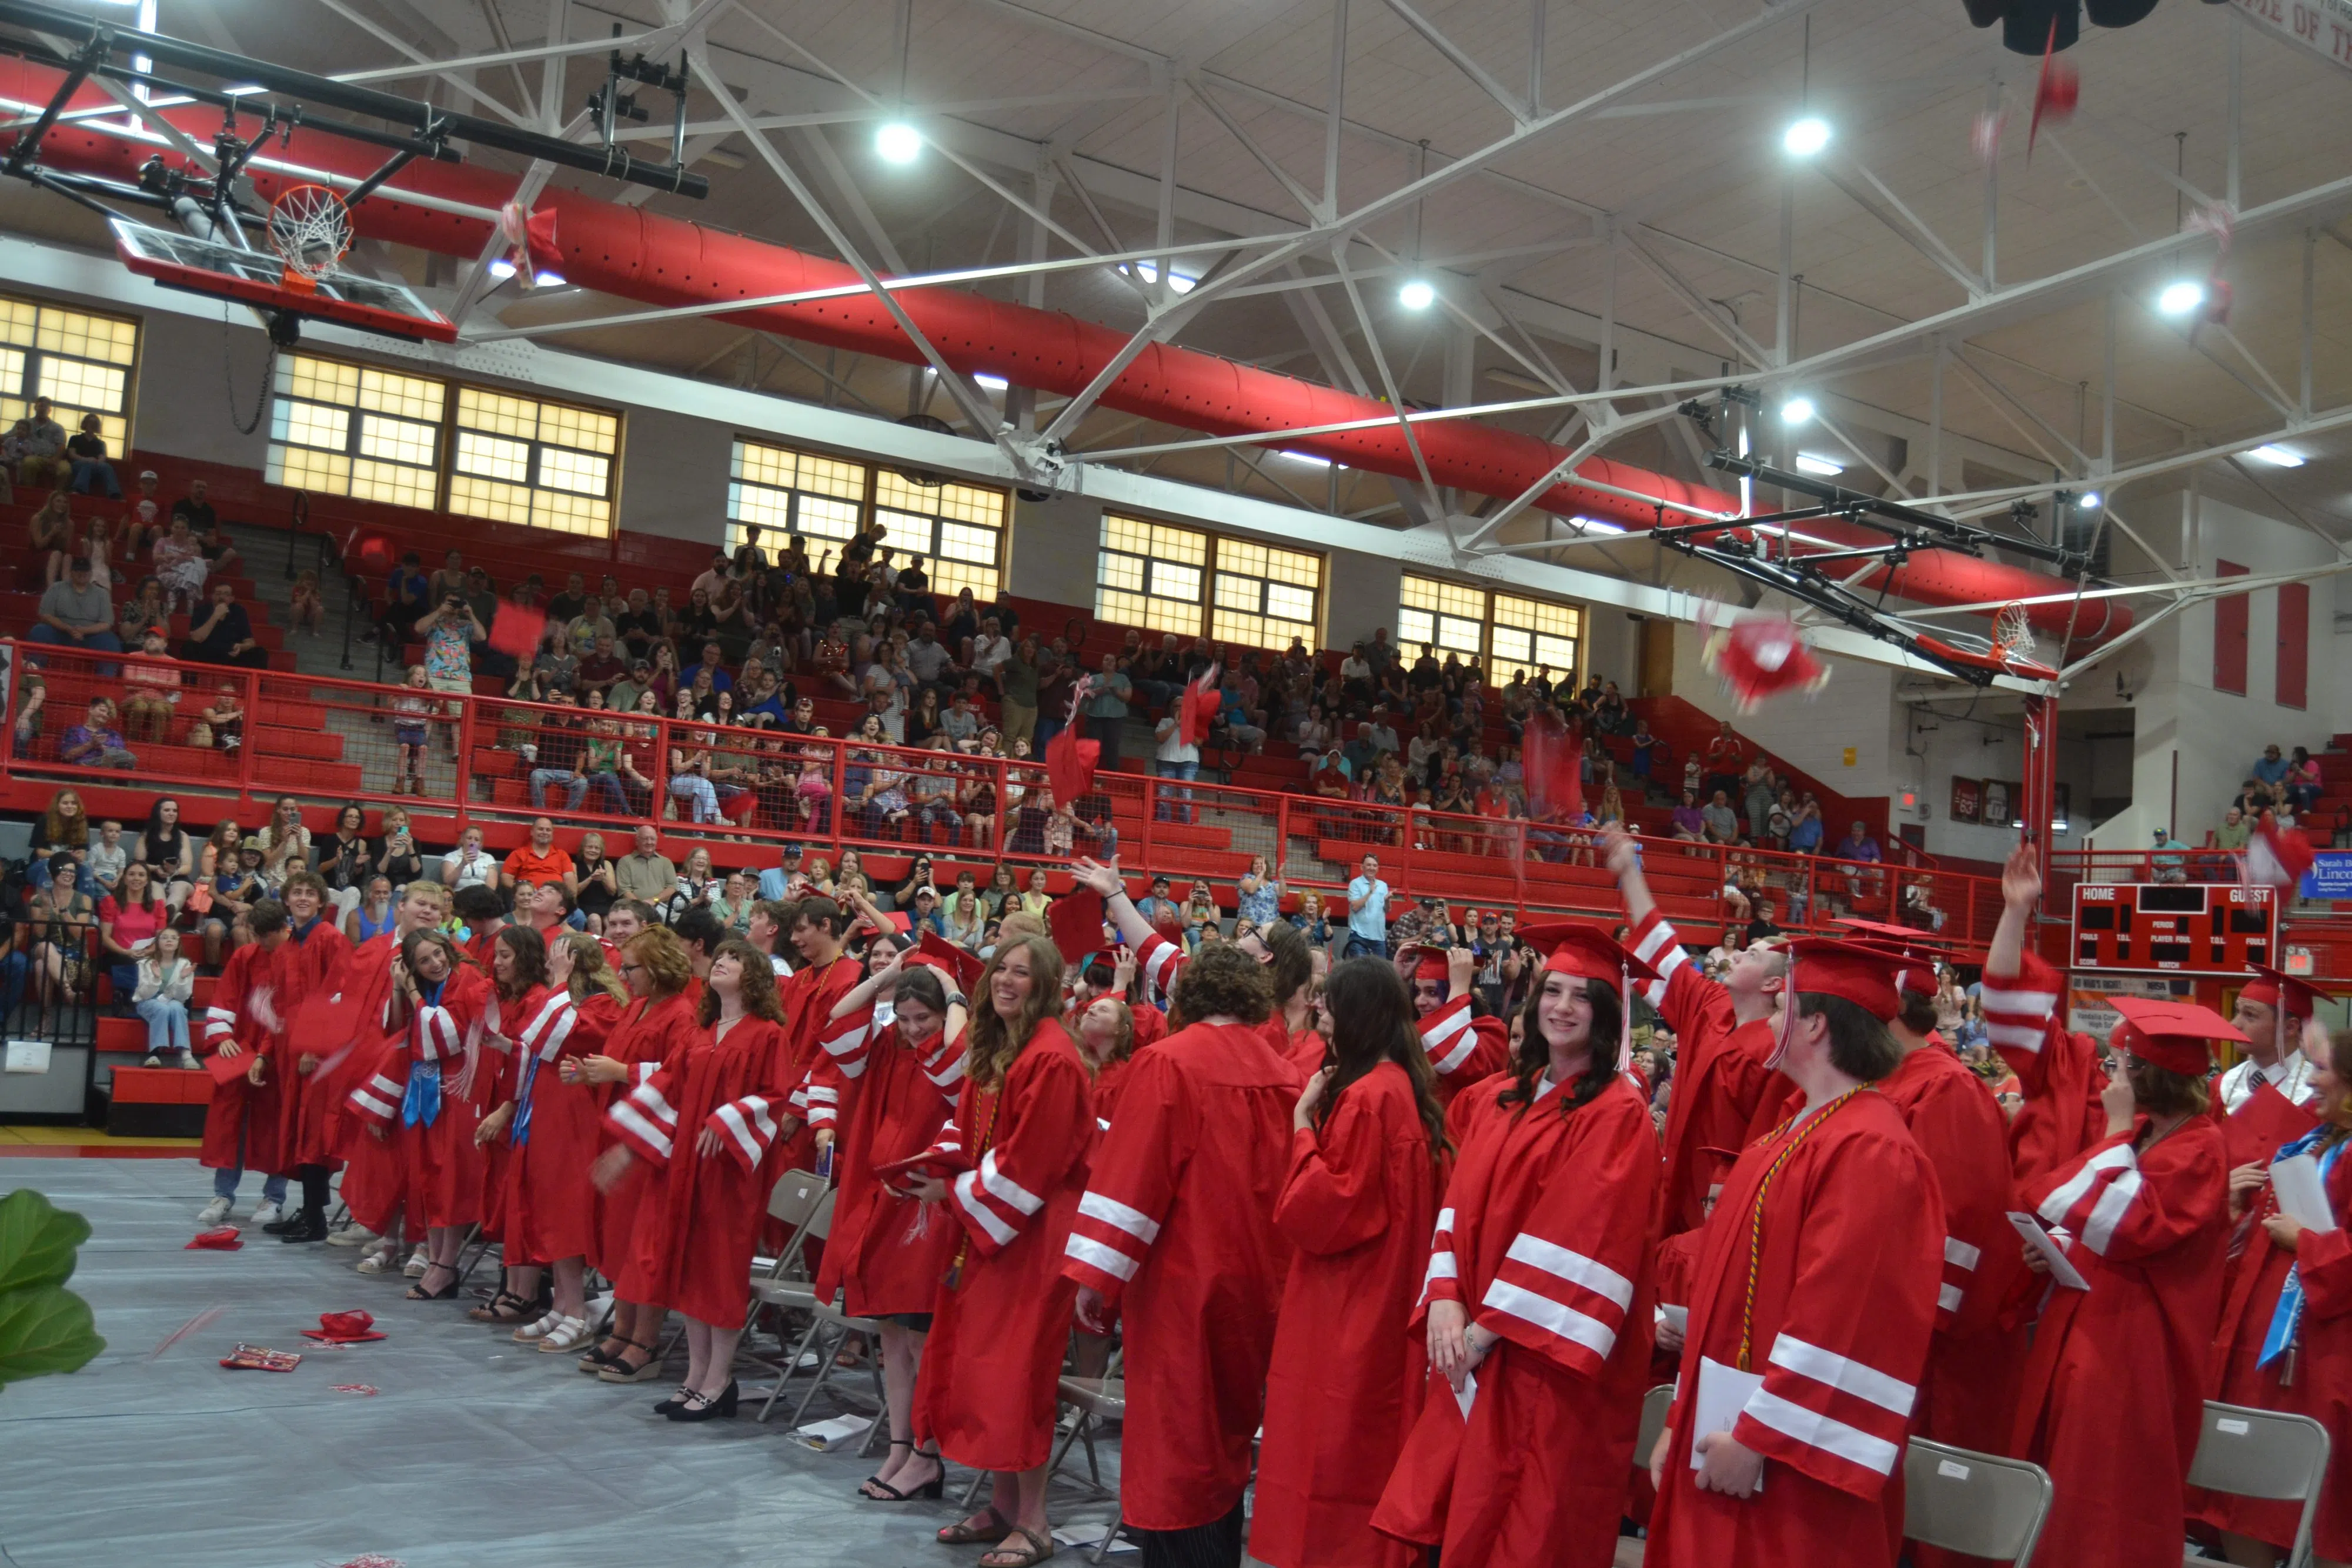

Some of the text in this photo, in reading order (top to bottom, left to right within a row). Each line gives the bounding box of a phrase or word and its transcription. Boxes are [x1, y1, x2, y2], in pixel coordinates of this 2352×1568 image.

[2294, 4, 2320, 41] OF
[1960, 798, 1973, 815] 63
[2083, 888, 2114, 900] HOME
[2230, 890, 2270, 902] GUST
[2077, 1012, 2102, 1021] Vandalia
